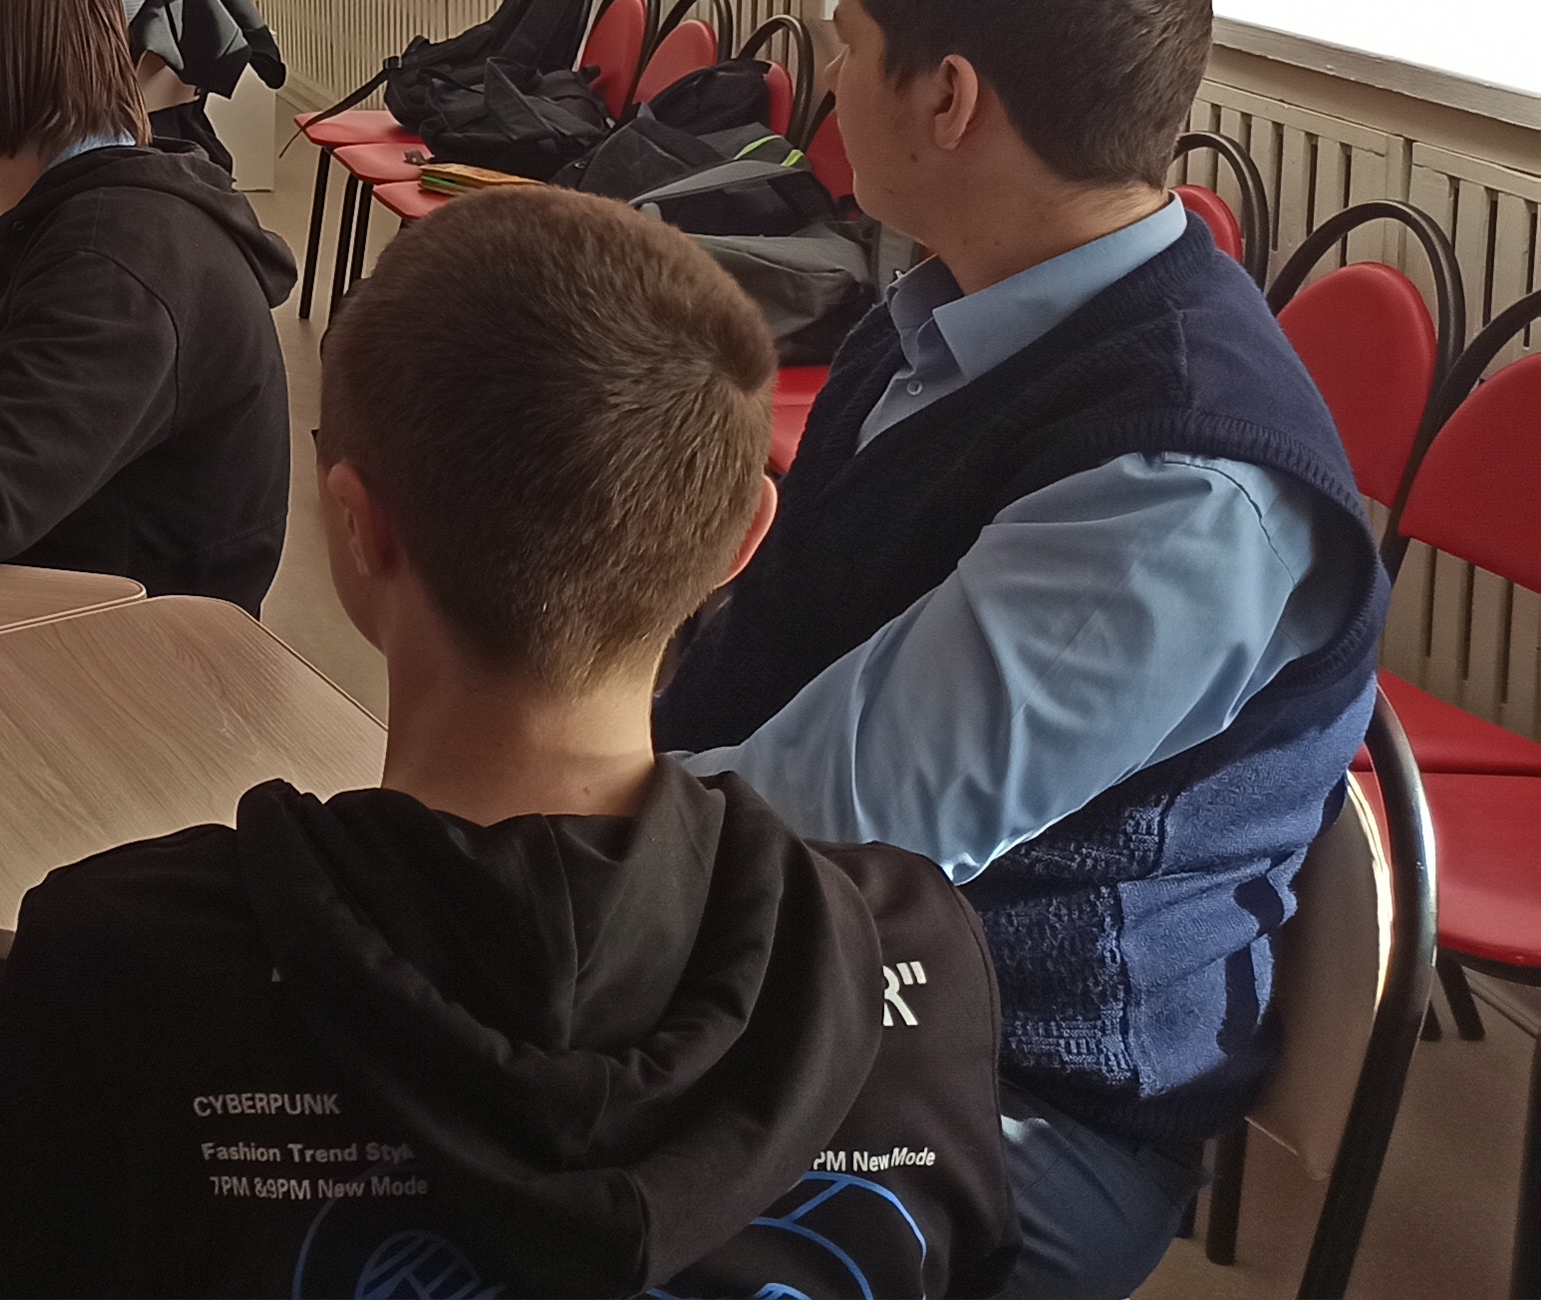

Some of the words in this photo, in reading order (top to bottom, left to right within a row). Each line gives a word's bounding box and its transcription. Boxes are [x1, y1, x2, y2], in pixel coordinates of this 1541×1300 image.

[193, 1092, 341, 1117] CYBERPUNK
[201, 1142, 281, 1162] Fashion
[287, 1143, 357, 1162] Trend
[852, 1151, 890, 1171] New
[891, 1147, 936, 1167] Mode
[209, 1175, 251, 1197] 7PM
[253, 1177, 312, 1200] &9PM
[318, 1178, 365, 1198] New
[371, 1176, 429, 1197] Mode
